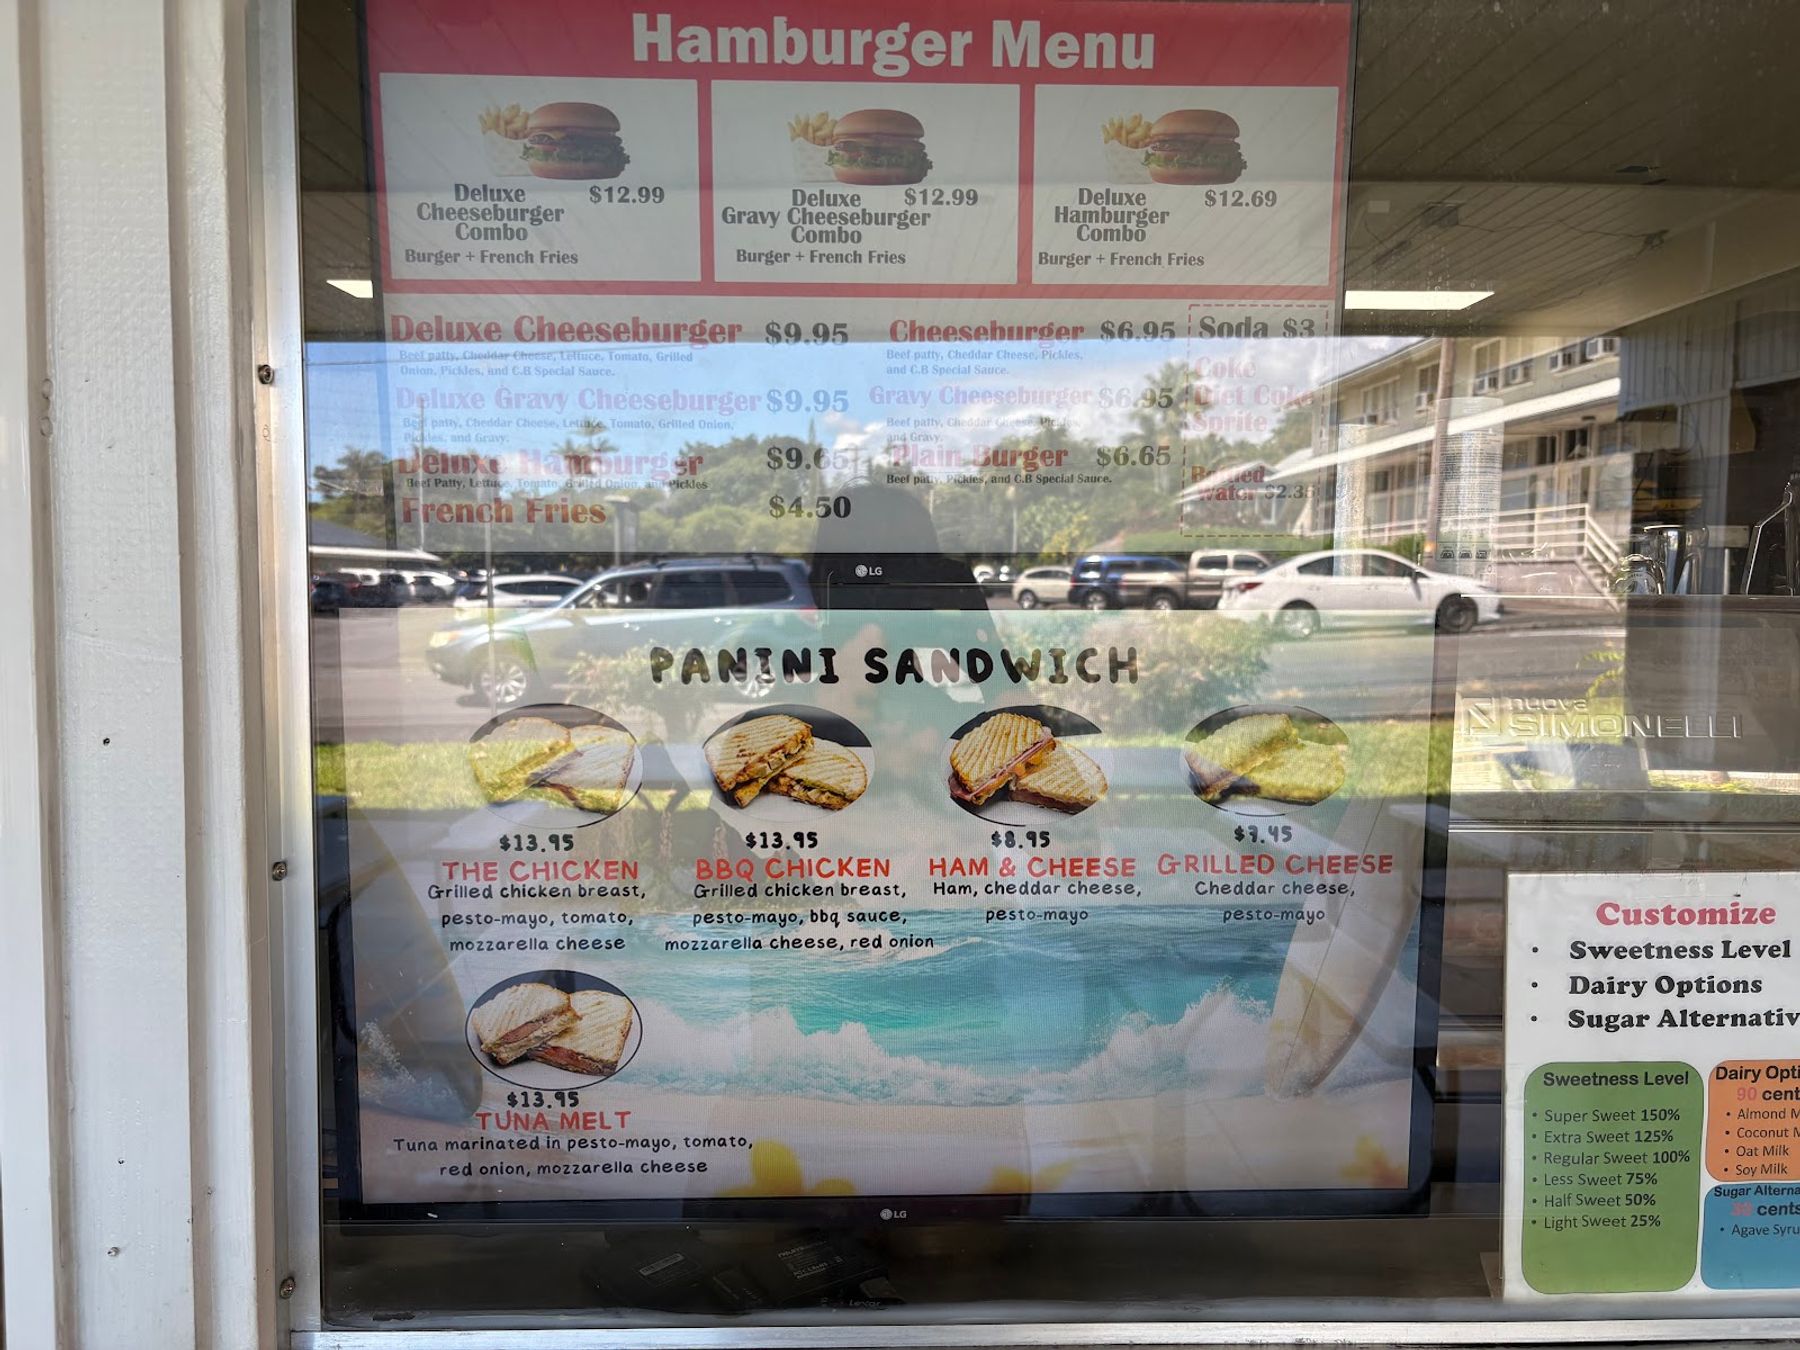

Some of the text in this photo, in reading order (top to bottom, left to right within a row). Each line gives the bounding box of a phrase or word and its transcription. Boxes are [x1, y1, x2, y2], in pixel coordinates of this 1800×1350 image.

[632, 13, 1155, 77] Hamburger Menu
[454, 183, 526, 202] Deluxe
[589, 185, 665, 204] $12.99
[792, 189, 861, 207] Deluxe
[904, 188, 978, 206] $12.99
[1078, 188, 1146, 206] Deluxe
[1205, 190, 1277, 208] $12.69
[417, 203, 565, 226] Cheeseburger
[722, 207, 931, 230] Gravy Cheeseburger
[1055, 206, 1170, 228] Hamburger
[455, 223, 528, 241] Combo
[791, 226, 862, 244] Combo
[1077, 224, 1146, 242] Combo
[405, 249, 578, 266] Burger French Fries
[736, 249, 906, 265] Burger French Fries
[1038, 252, 1205, 268] Burger French Fries
[390, 315, 742, 349] Deluxe Cheeseburger
[765, 320, 849, 346] $9.95
[889, 319, 1085, 349] Cheeseburger
[1100, 320, 1176, 343] $6.95
[1199, 316, 1315, 339] Soda $3
[886, 350, 910, 360] Beef
[948, 350, 993, 360] Cheddar
[886, 365, 906, 374] and
[932, 365, 971, 376] Special
[974, 365, 1009, 375] Sauce.
[396, 386, 762, 416] Deluxe Gravy Cheeseburger
[766, 388, 849, 413] $9.95
[973, 445, 1068, 471] Burger
[1096, 444, 1171, 467] $6.65
[991, 474, 1010, 483] and
[1036, 474, 1074, 485] Special
[1077, 474, 1112, 483] Sauce.
[402, 498, 606, 523] French Fries
[769, 495, 851, 519] $4.50
[868, 566, 882, 575] LG
[649, 645, 1140, 686] PANINI SANDWICH
[1507, 698, 1588, 711] nuova
[1509, 714, 1743, 738] SIMONELLI
[500, 834, 574, 853] $13.95
[745, 831, 818, 850] $13.95
[991, 829, 1051, 849] $8.95
[442, 859, 639, 882] THE CHICKEN
[696, 857, 891, 882] BBQ CHICKEN
[929, 856, 1136, 877] HAM & CHEESE
[1158, 853, 1394, 875] GRILLED CHEESE
[428, 883, 646, 900] Grilled chicken breast,
[694, 881, 906, 899] Grilled chicken breast,
[933, 880, 1142, 898] Ham, cheddar cheese,
[1194, 880, 1355, 898] Cheddar cheese,
[441, 910, 634, 929] pesto-mayo, tomato,
[692, 908, 907, 928] pesto-mayo, bbq sauce,
[985, 907, 1089, 925] pesto-mayo
[1223, 907, 1325, 925] pesto-mayo
[1596, 902, 1776, 926] Customize
[450, 935, 625, 952] mozzarella cheese
[665, 933, 934, 953] mozzarella cheese, red onion
[1570, 940, 1791, 960] Sweetness Level
[1569, 975, 1762, 998] Dairy Options
[1568, 1009, 1650, 1032] Sugar
[1543, 1071, 1689, 1086] Sweetness Level
[1716, 1066, 1761, 1083] Dairy
[507, 1091, 580, 1109] $13.95
[1737, 1088, 1757, 1100] 90
[475, 1110, 632, 1131] TUNA MELT
[1544, 1109, 1680, 1124] Super Sweet 150%
[1737, 1108, 1786, 1119] Almond
[1544, 1130, 1673, 1143] Extra Sweet 125%
[1737, 1128, 1788, 1138] Coconut
[393, 1133, 753, 1153] Tuna marinated in pesto-mayo, tomato,
[1736, 1145, 1789, 1156] Oat Milk
[1544, 1151, 1690, 1167] Regular Sweet 100%
[440, 1159, 708, 1178] red onion, mozzarella cheese
[1735, 1164, 1788, 1176] Soy Milk
[1544, 1173, 1657, 1185] Less Sweet 75%
[1544, 1194, 1656, 1207] Half Sweet 50%
[1714, 1186, 1751, 1199] Sugar
[893, 1209, 907, 1219] LG
[1544, 1215, 1661, 1231] Light Sweet 25%
[1732, 1224, 1769, 1238] Agave
